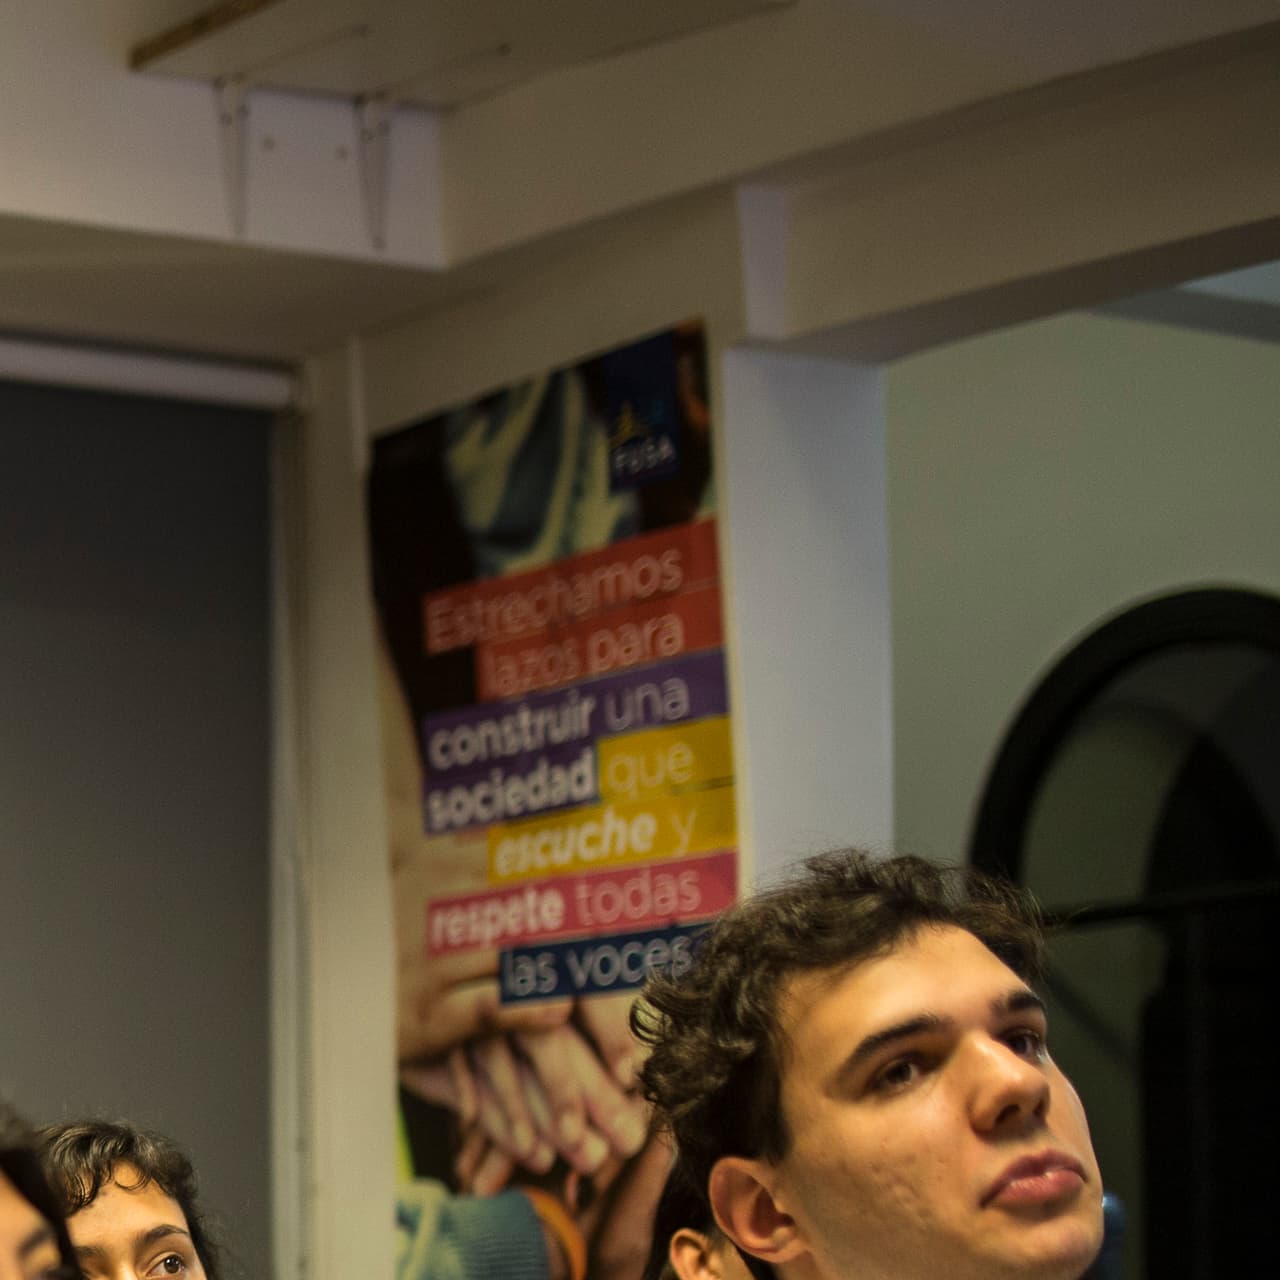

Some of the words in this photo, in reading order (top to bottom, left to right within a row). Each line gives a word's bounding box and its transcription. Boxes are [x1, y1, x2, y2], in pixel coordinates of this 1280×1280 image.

[429, 548, 684, 648] Estrechamos
[484, 637, 580, 694] lazos
[587, 612, 686, 675] para
[429, 693, 596, 770] construir
[604, 677, 690, 729] una
[428, 748, 595, 832] sociedad
[607, 741, 694, 799] que
[495, 807, 657, 877] escuche
[671, 806, 698, 858] y
[429, 886, 566, 948] respete
[577, 868, 701, 927] todas
[504, 947, 559, 997] las
